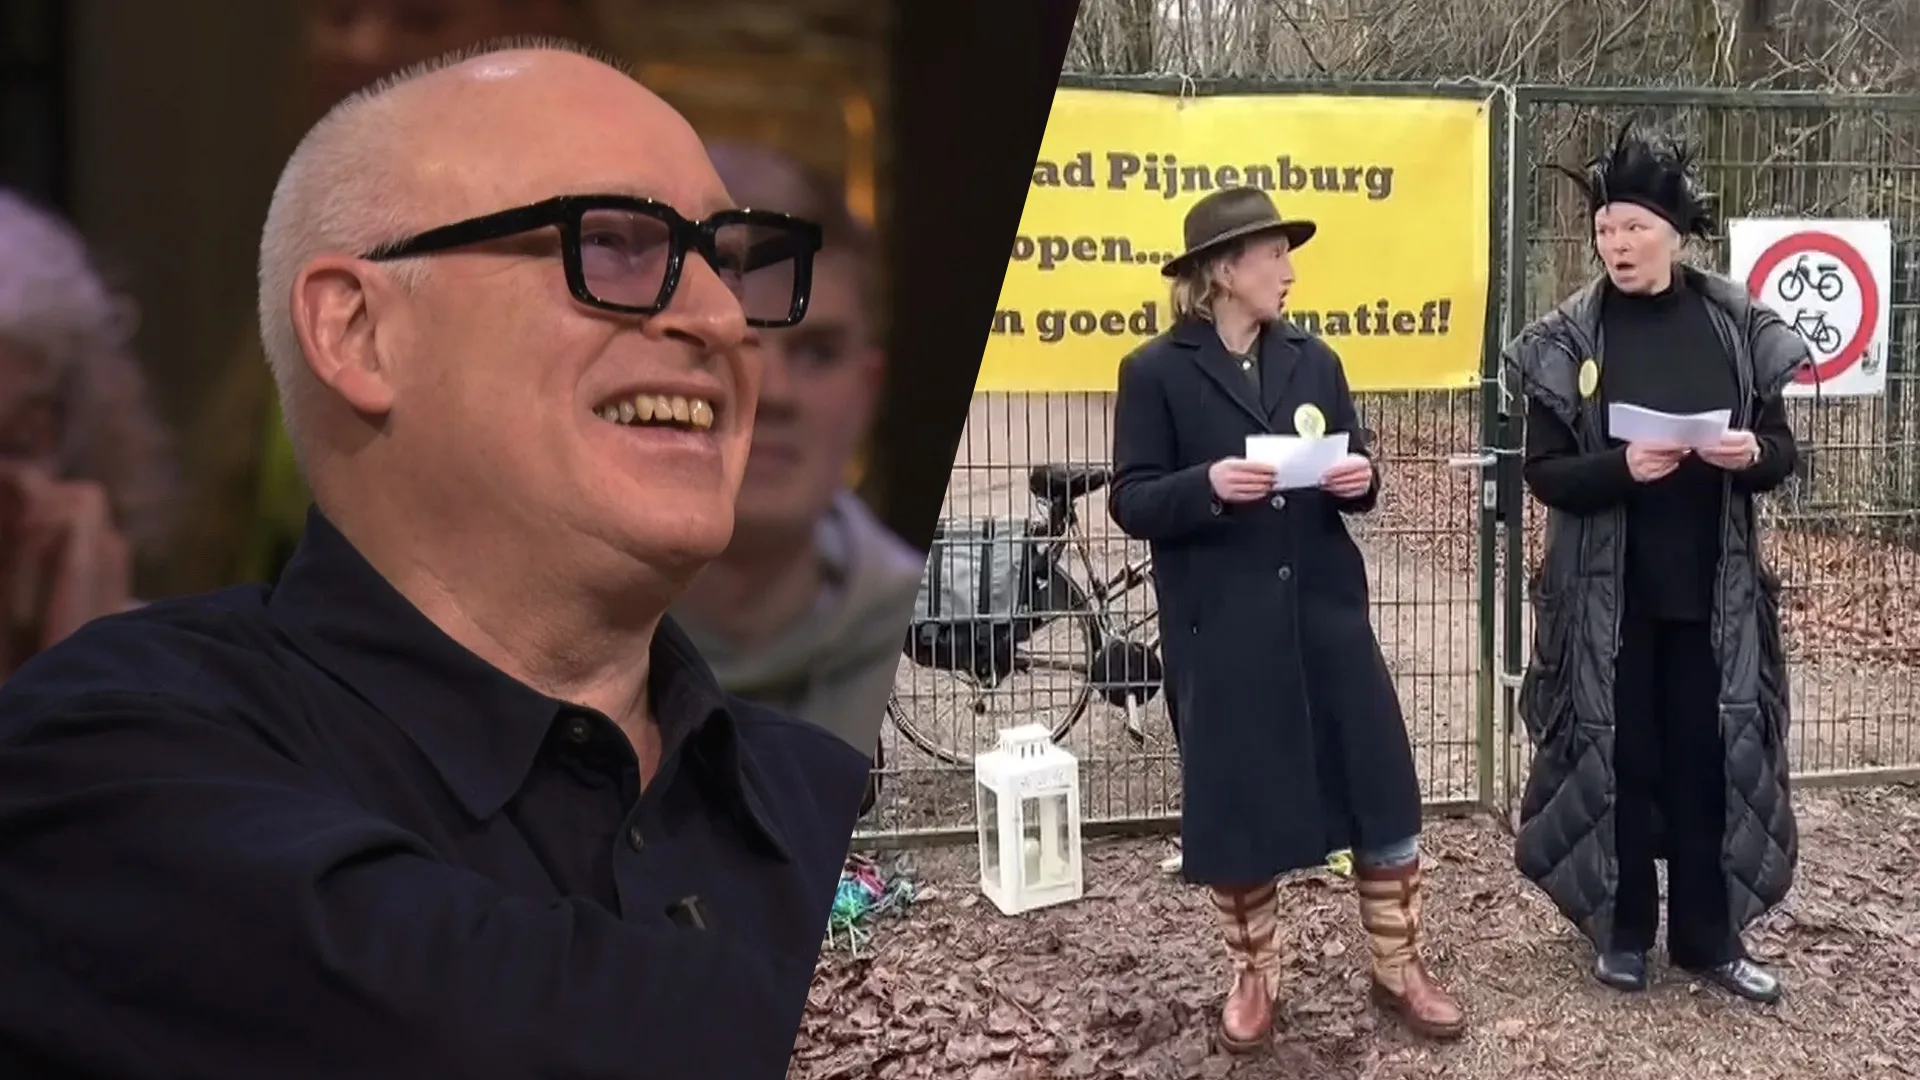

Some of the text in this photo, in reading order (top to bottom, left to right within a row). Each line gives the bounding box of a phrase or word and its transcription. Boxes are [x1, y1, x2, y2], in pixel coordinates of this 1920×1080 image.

[1033, 152, 1394, 200] ad Pijnenburg
[1036, 302, 1159, 343] goed
[1282, 298, 1451, 337] natief!
